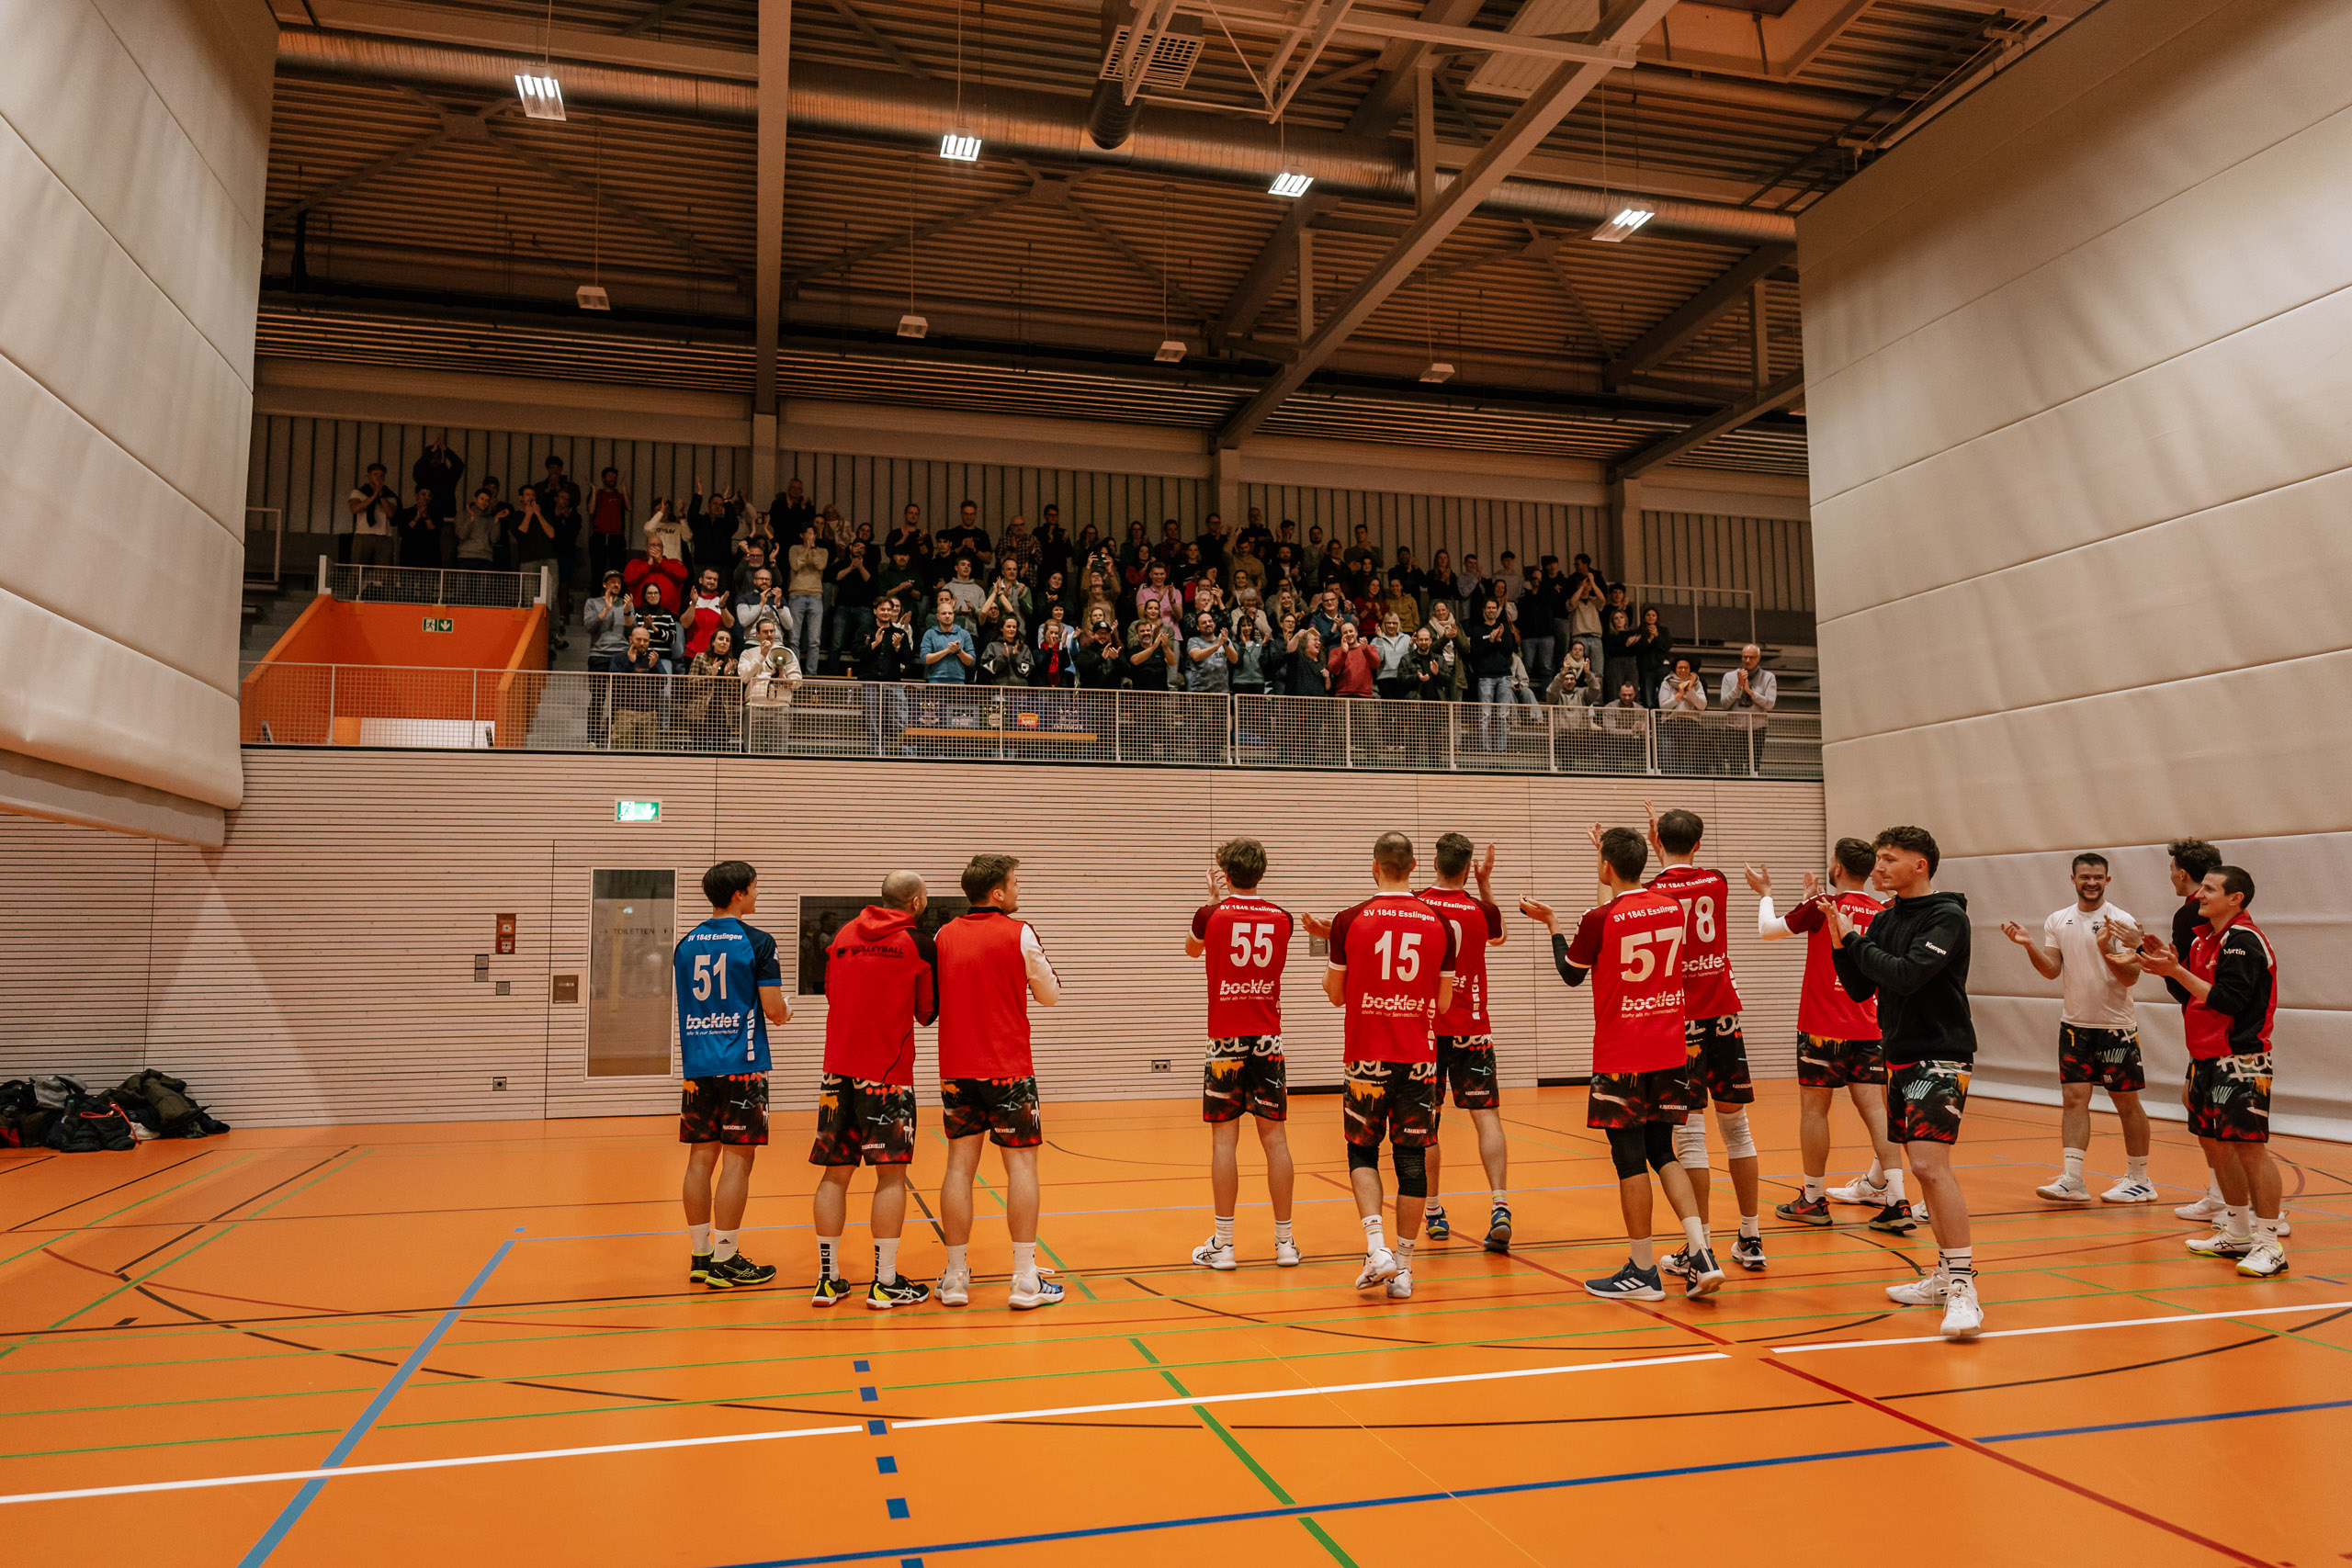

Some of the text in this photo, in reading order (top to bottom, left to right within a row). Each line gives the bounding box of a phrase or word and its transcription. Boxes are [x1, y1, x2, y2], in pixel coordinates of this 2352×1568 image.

[1687, 876, 1718, 886] Esslingen
[1426, 898, 1442, 907] 1845
[1442, 901, 1476, 910] Esslingen
[1851, 905, 1865, 913] 1845
[1376, 908, 1396, 917] 1845
[1398, 910, 1435, 921] Esslingen
[1613, 905, 1679, 922] SV 1845 Esslingen
[1229, 922, 1274, 968] 55
[1925, 941, 1947, 955] Kempa
[2223, 948, 2246, 956] Martin
[1374, 930, 1422, 982] 15
[1621, 926, 1683, 982] 57
[692, 953, 728, 1001] 51
[1361, 992, 1425, 1011] bocklet
[1621, 989, 1681, 1011] bocklet
